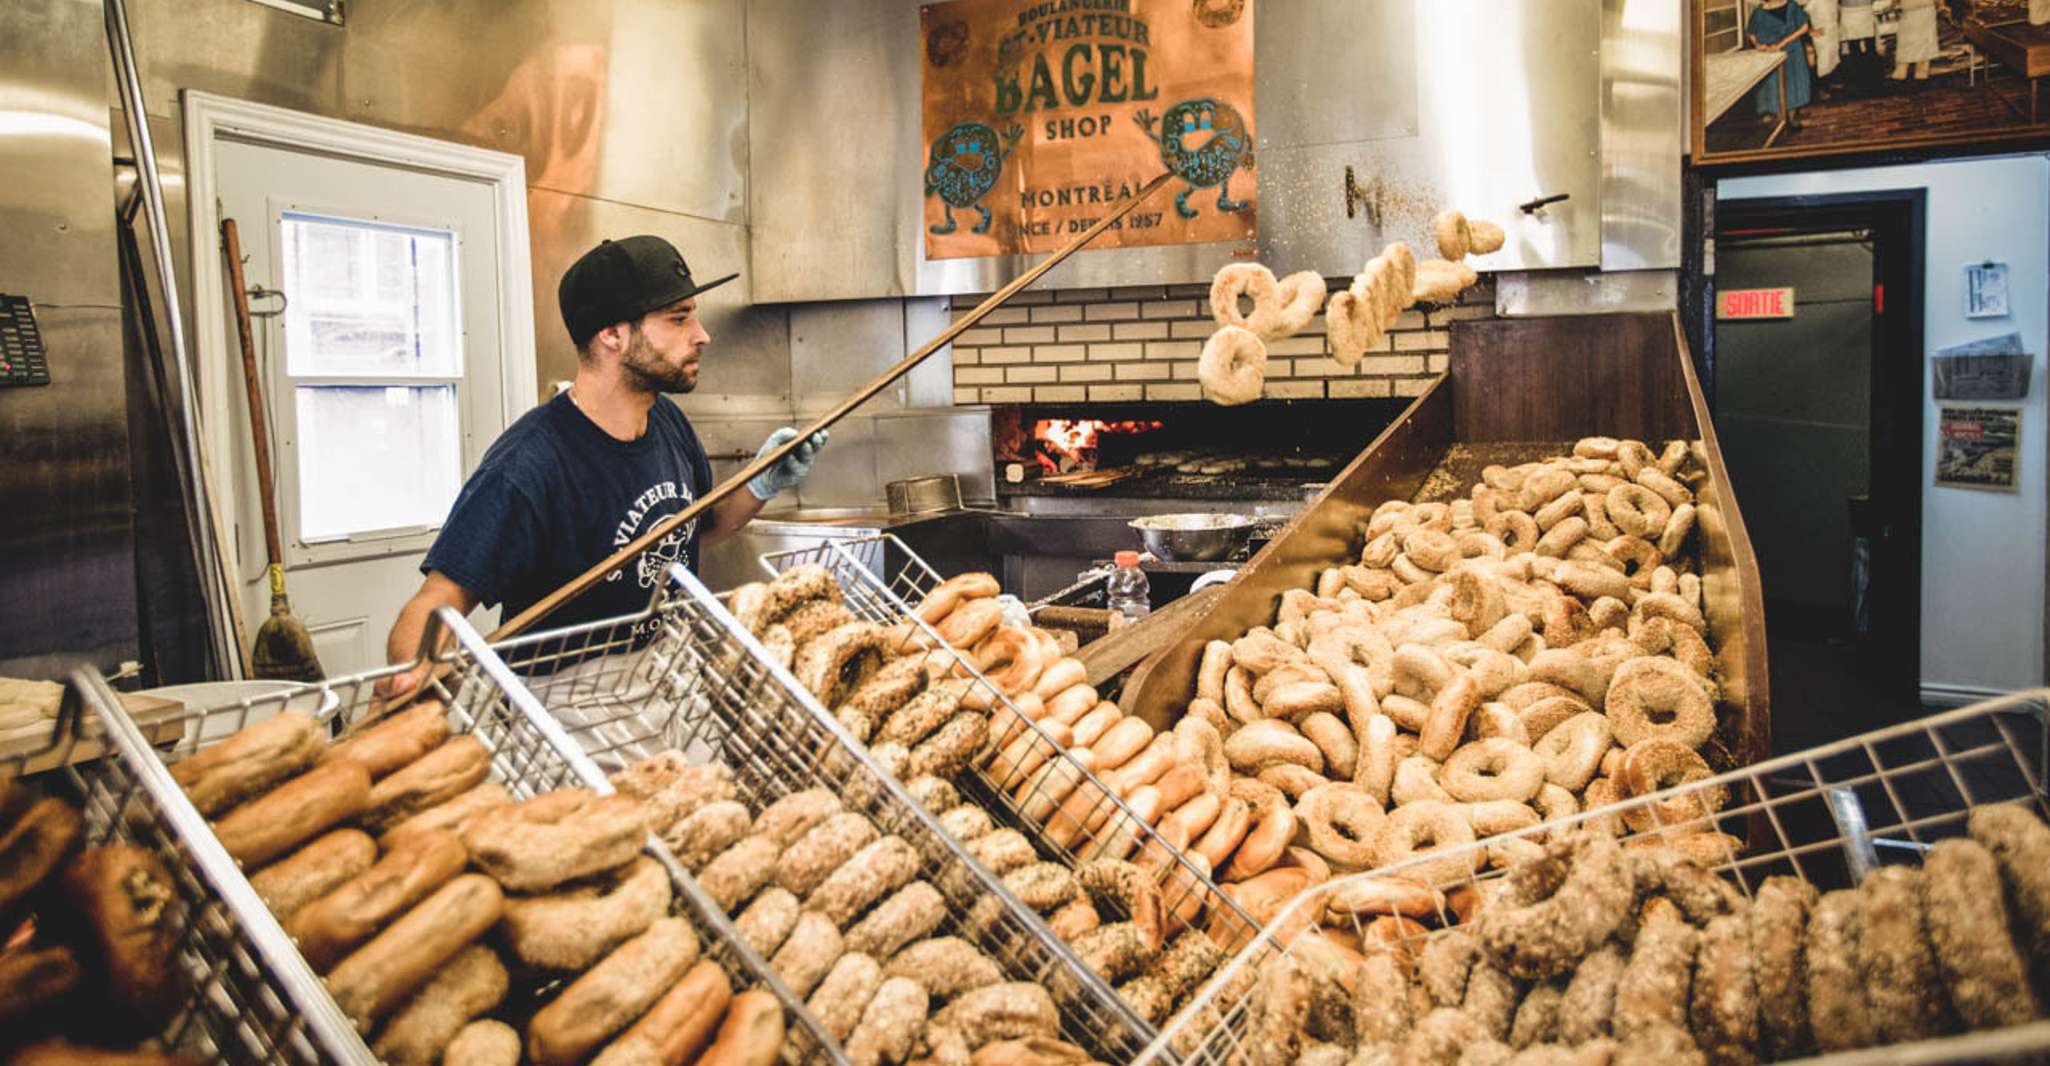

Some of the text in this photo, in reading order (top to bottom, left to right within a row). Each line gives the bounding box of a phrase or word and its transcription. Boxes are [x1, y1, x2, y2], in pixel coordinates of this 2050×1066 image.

[994, 43, 1158, 116] BAGEL
[1045, 115, 1111, 140] SHOP
[1129, 212, 1163, 230] 1957
[1726, 289, 1784, 317] SORTIE
